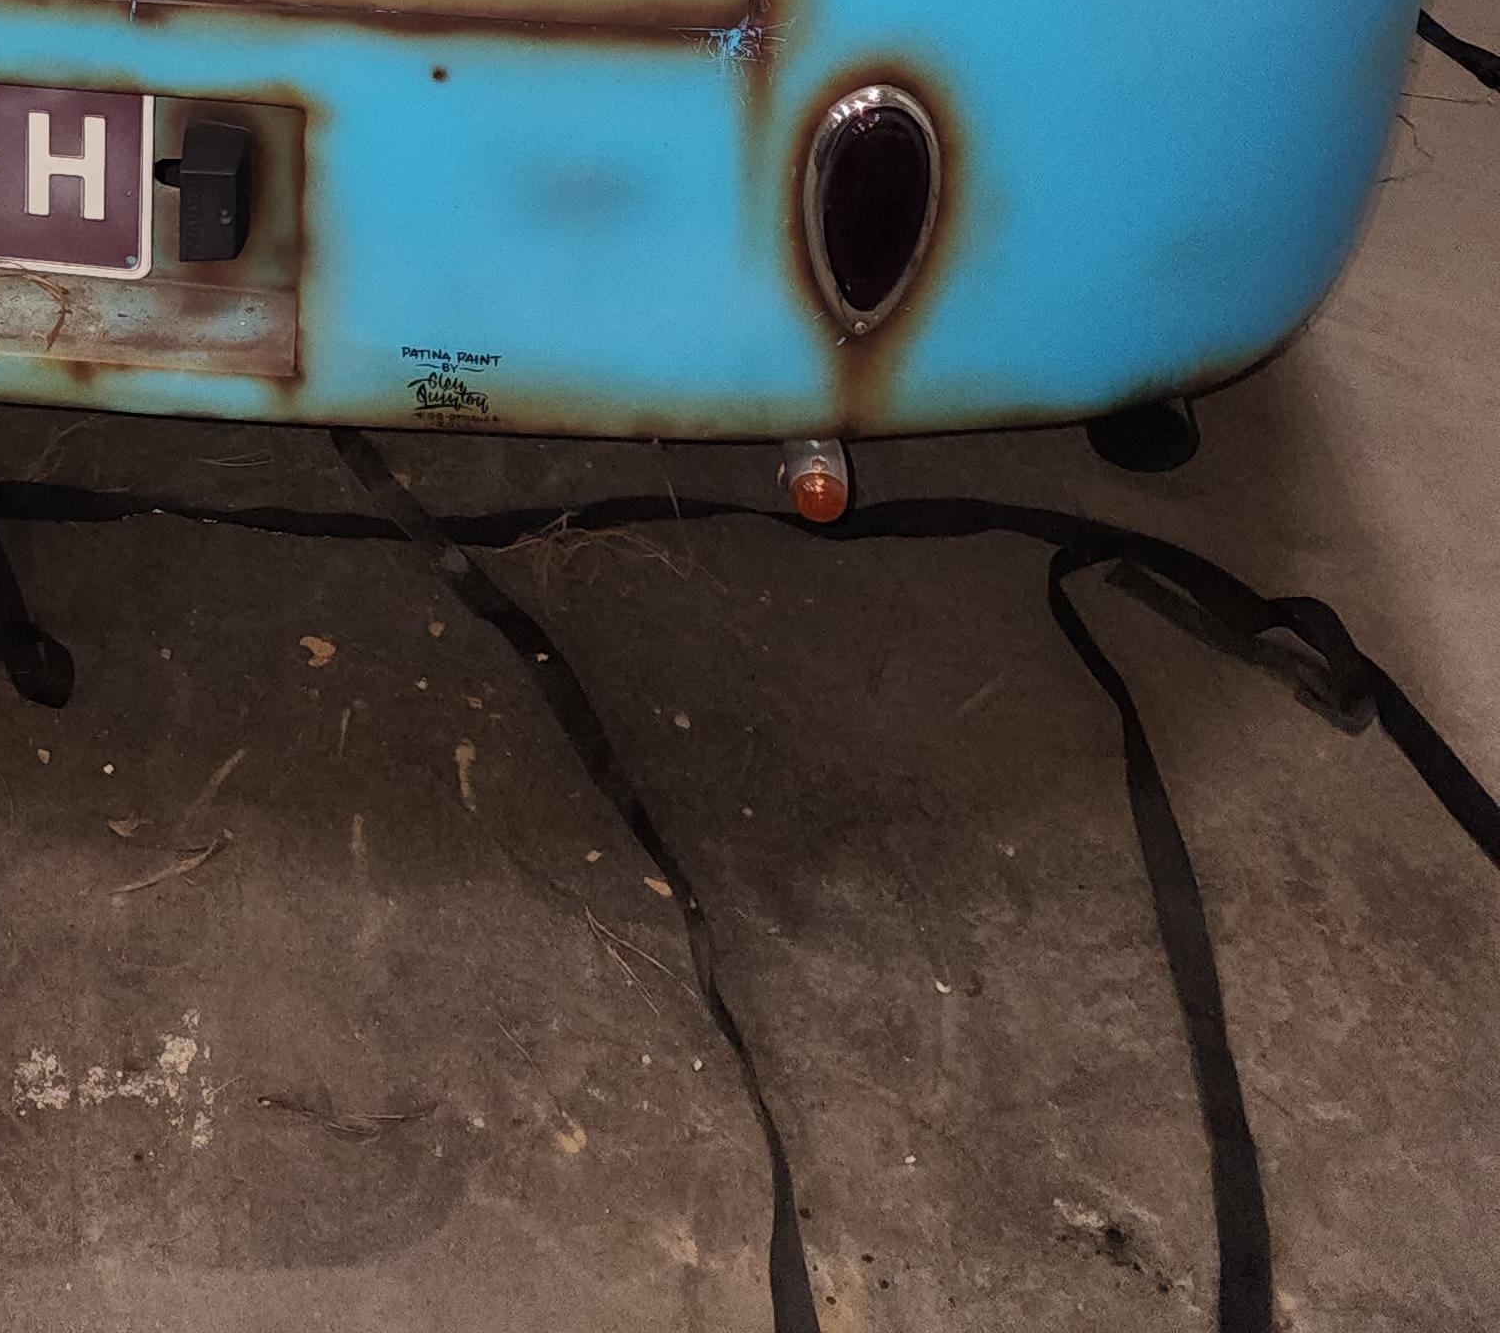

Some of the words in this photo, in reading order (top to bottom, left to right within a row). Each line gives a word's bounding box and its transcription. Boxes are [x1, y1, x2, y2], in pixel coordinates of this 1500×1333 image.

[401, 346, 451, 363] PATINA
[456, 351, 502, 368] PAINT
[441, 362, 458, 374] BY
